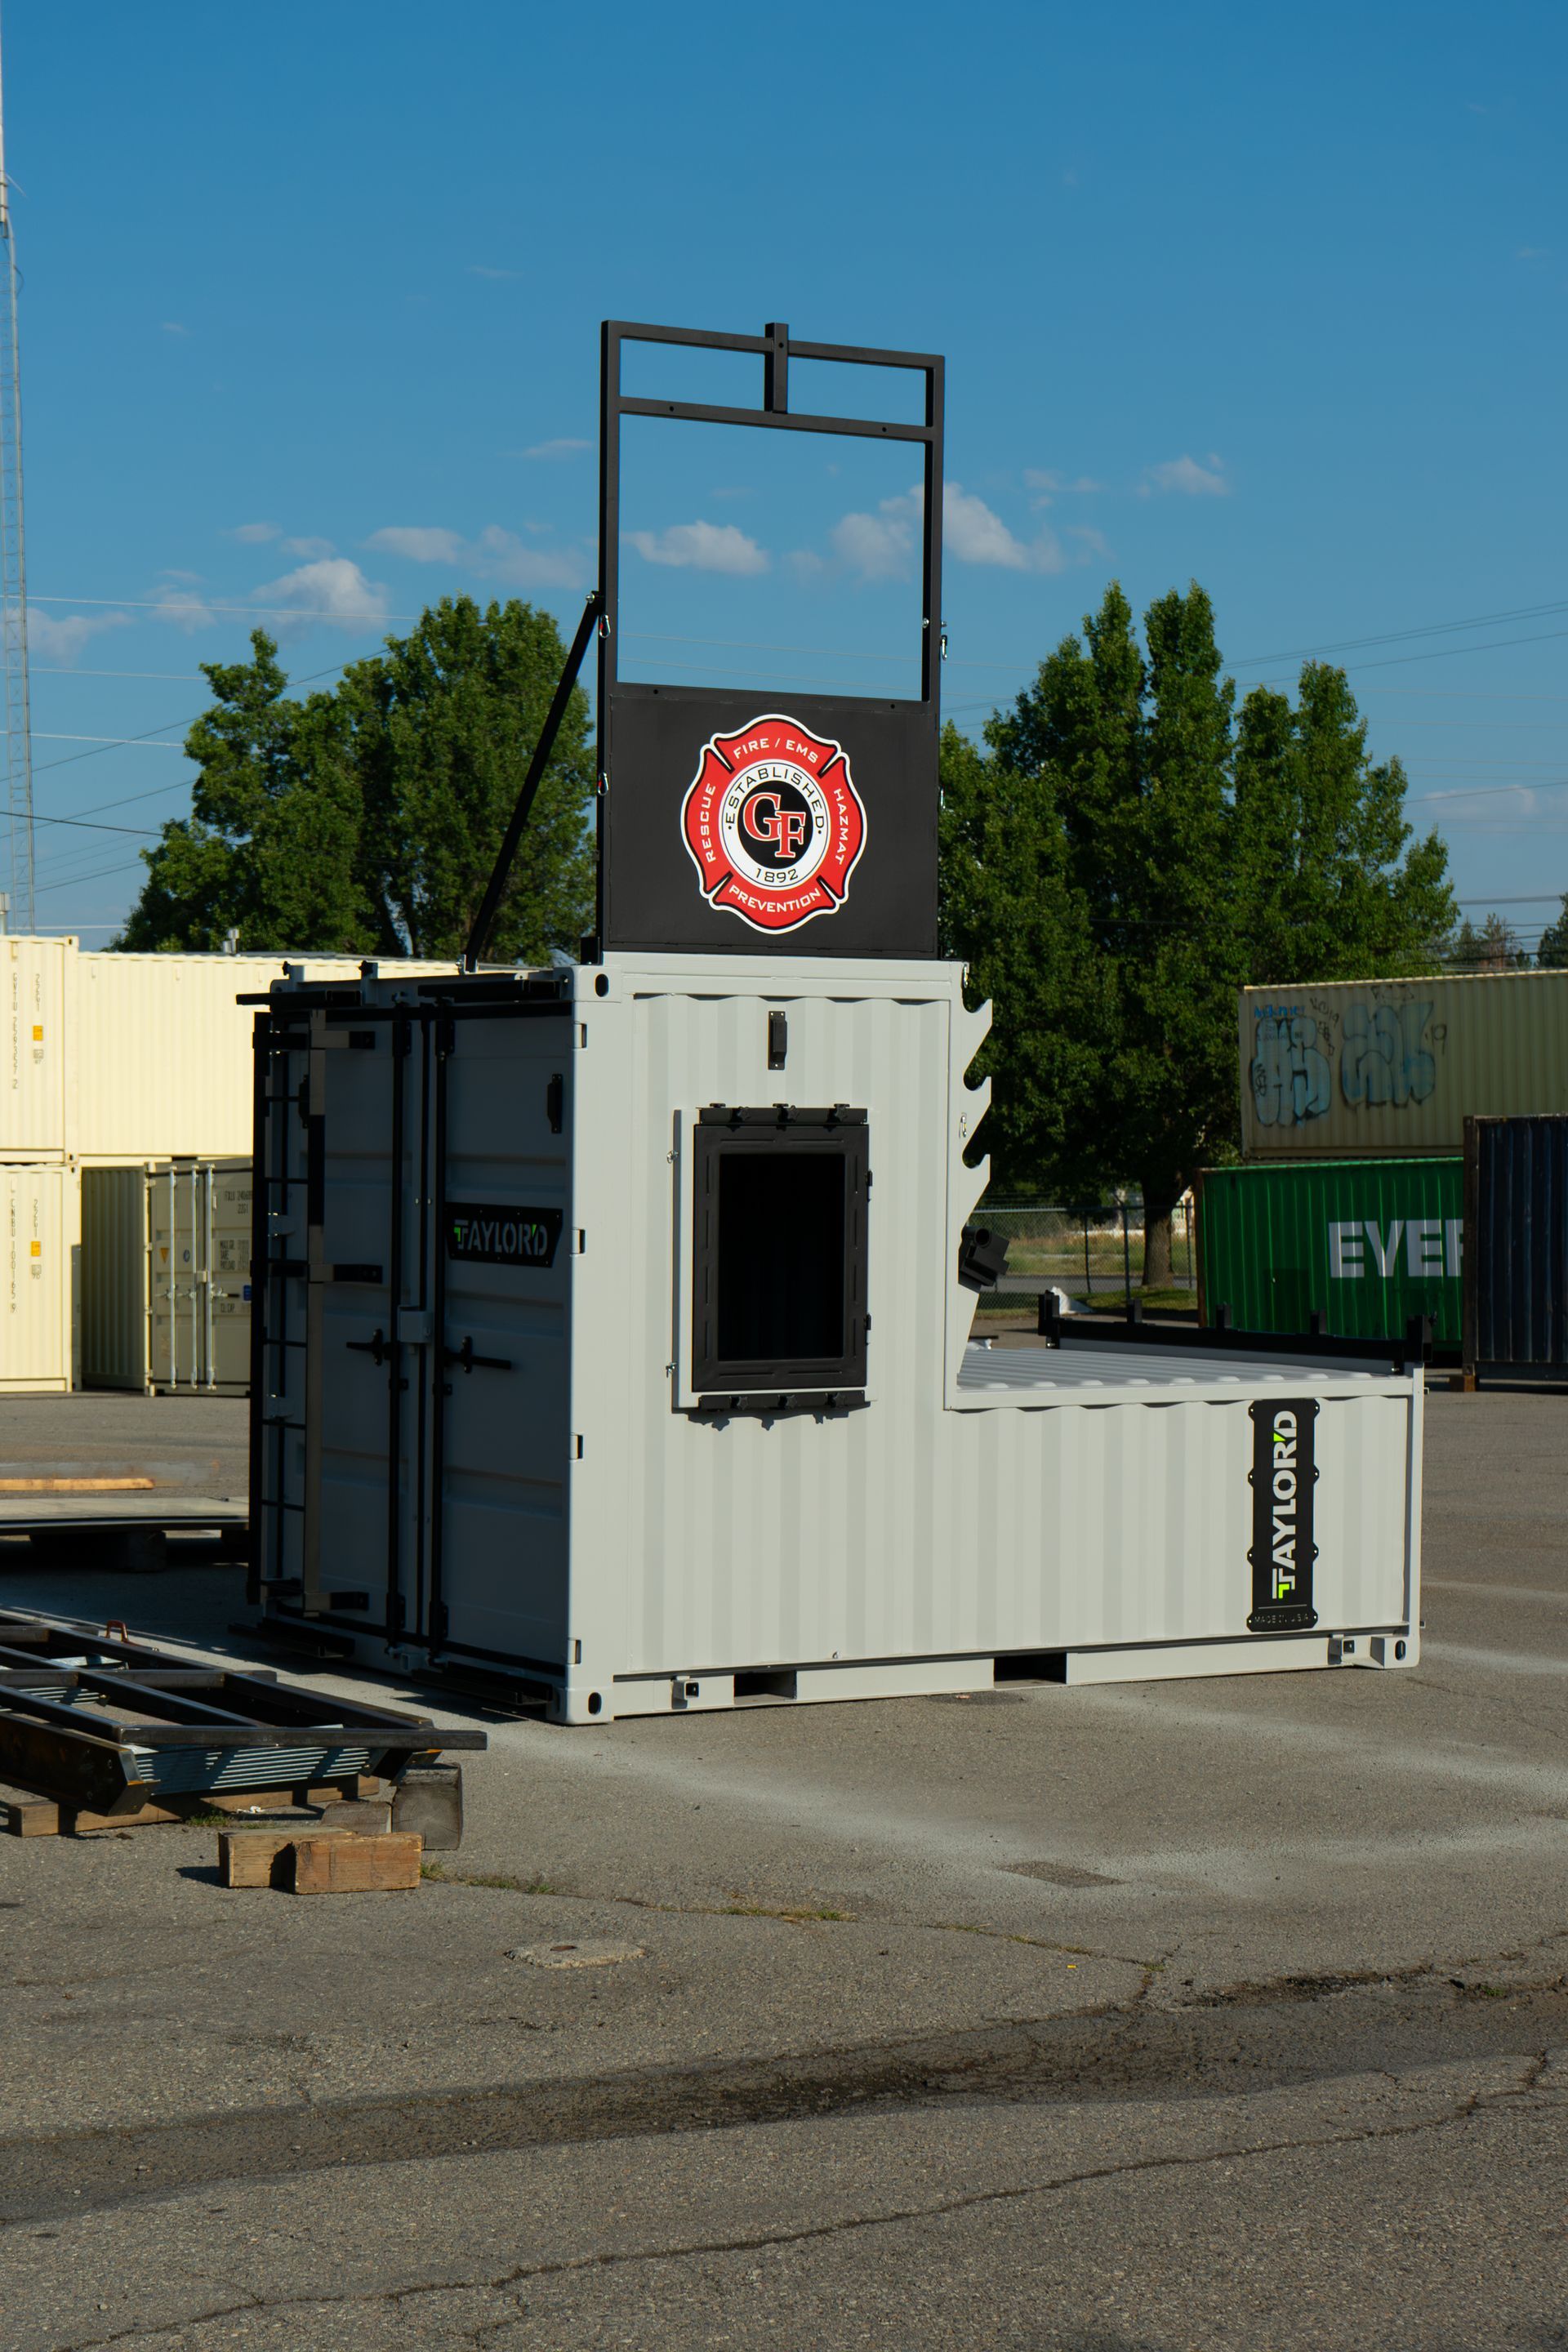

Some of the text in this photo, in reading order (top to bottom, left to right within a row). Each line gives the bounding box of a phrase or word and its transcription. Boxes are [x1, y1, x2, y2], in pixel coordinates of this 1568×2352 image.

[733, 737, 818, 764] FIRE / EMS
[699, 783, 716, 863] RESCUE
[725, 768, 825, 830] ESTABLISHED
[743, 791, 807, 858] GF
[833, 788, 849, 865] HAZMAT
[728, 884, 822, 913] PREVENTION
[755, 868, 799, 884] 1892
